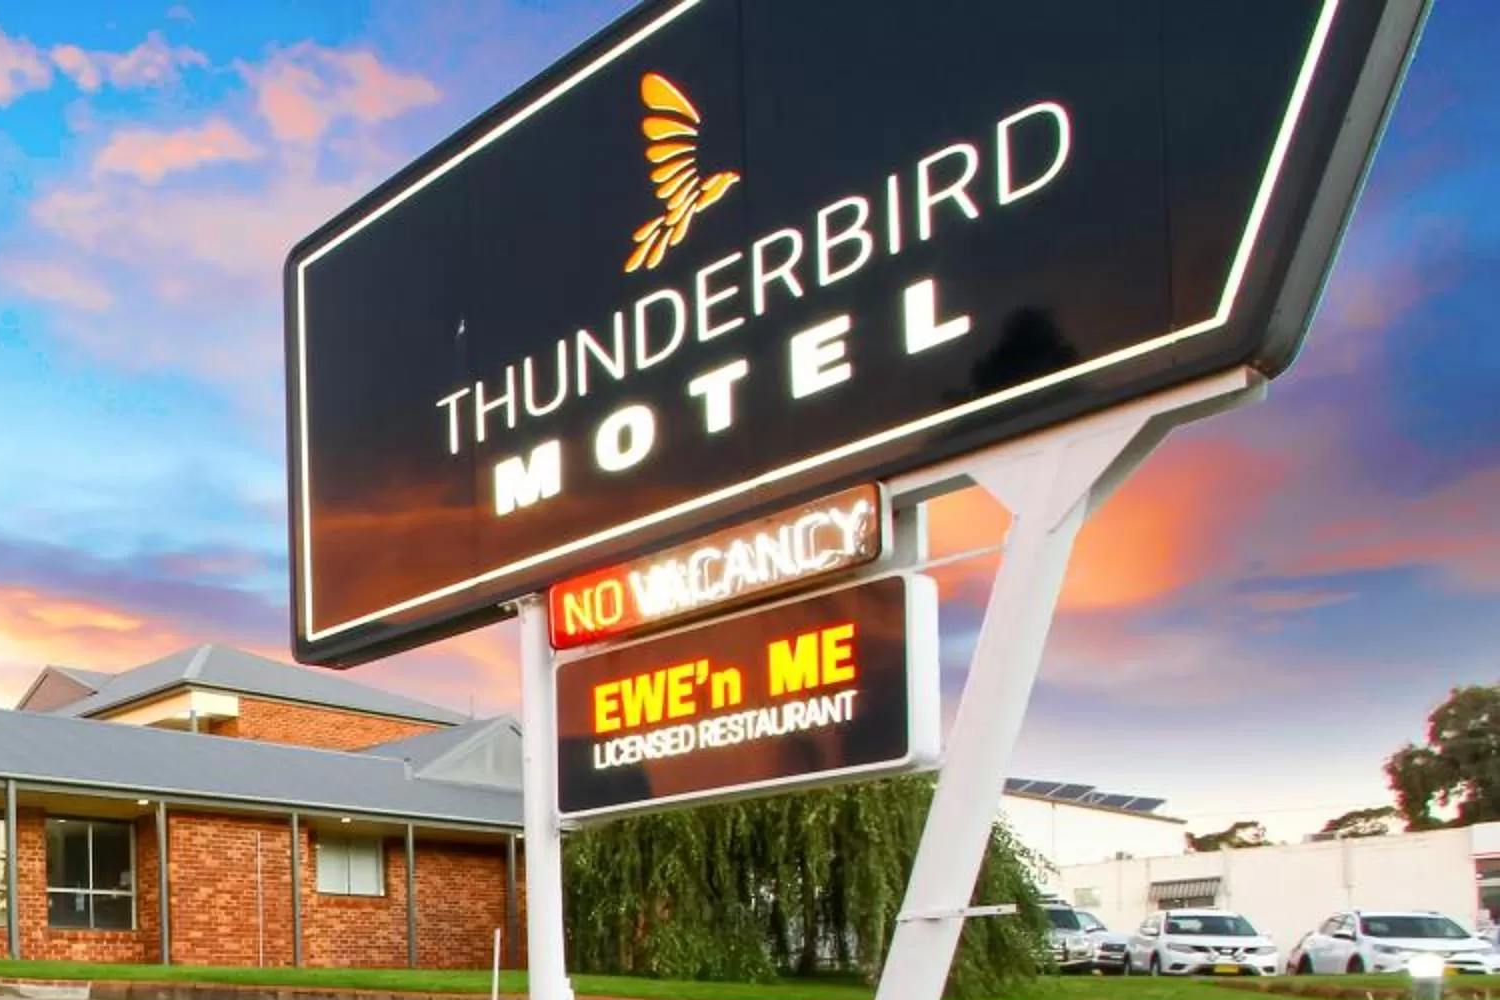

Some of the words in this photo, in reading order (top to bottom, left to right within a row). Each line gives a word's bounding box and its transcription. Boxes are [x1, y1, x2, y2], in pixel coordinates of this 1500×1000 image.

[436, 101, 1071, 454] THUNDERBIRD
[494, 278, 971, 517] MOTEL
[563, 579, 624, 635] NO
[627, 499, 872, 617] VACANCY
[769, 623, 856, 697] ME
[593, 724, 695, 770] LICENSED
[698, 689, 858, 750] RESTAURANT
